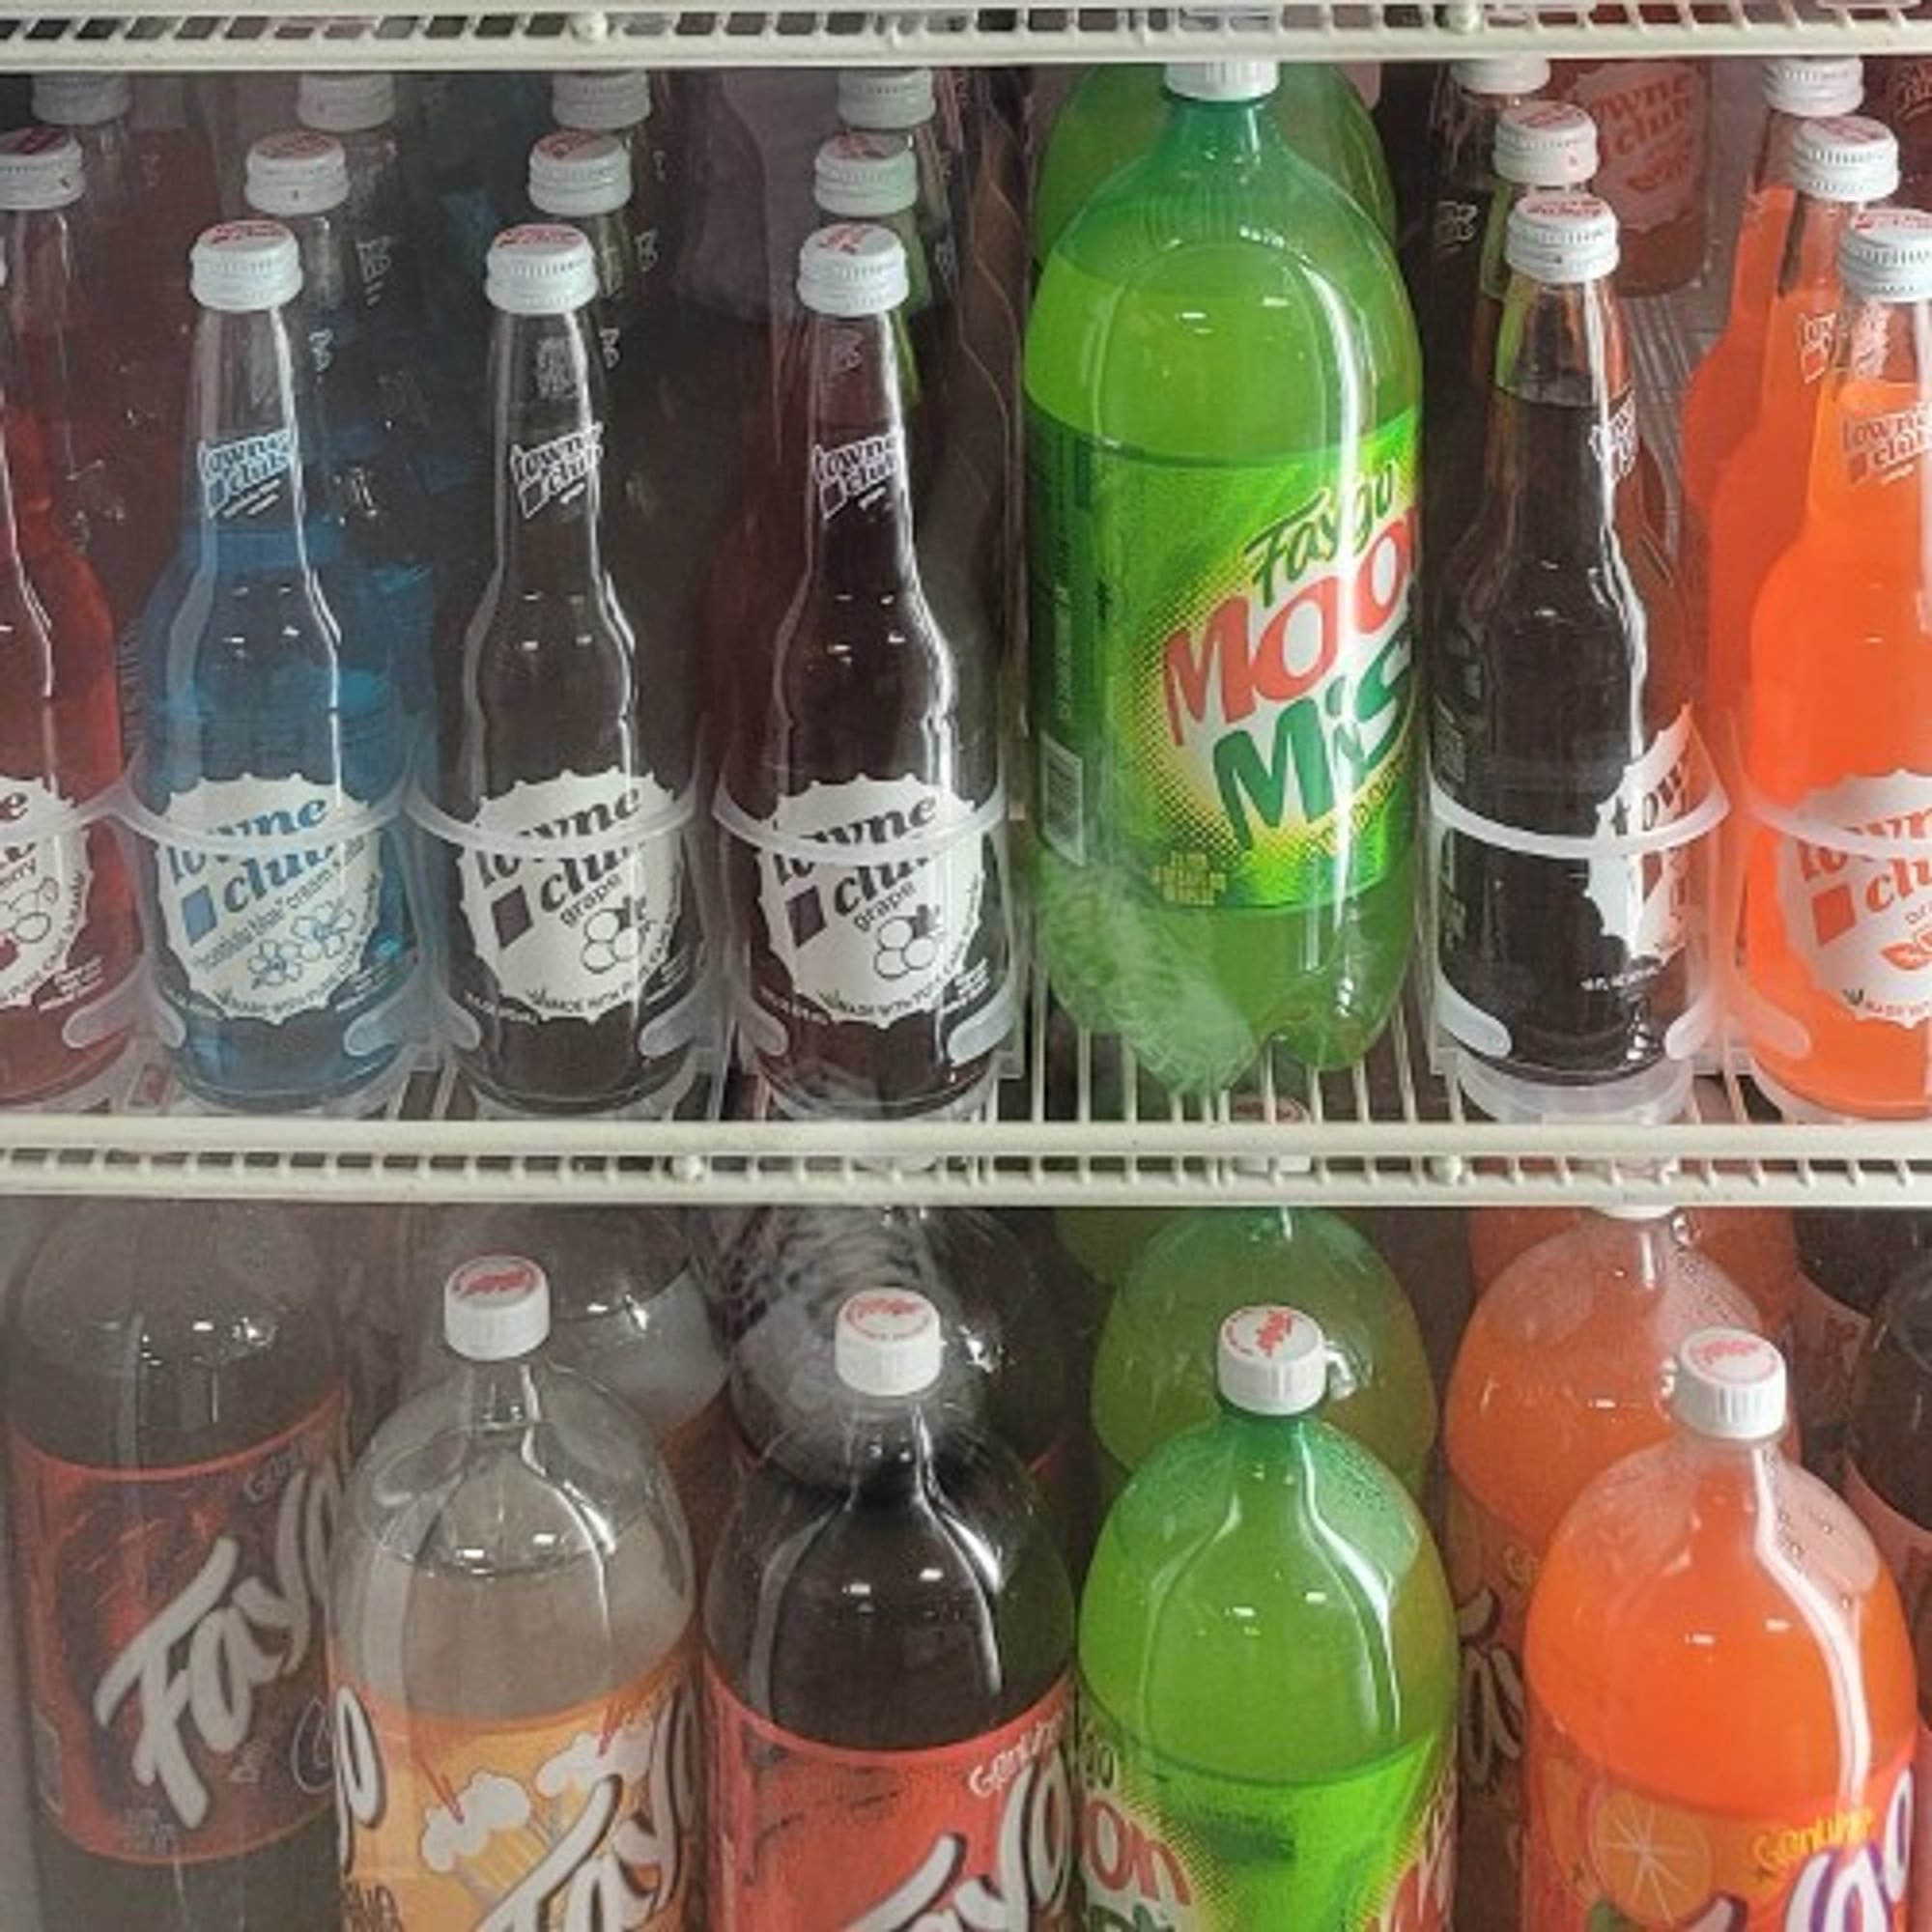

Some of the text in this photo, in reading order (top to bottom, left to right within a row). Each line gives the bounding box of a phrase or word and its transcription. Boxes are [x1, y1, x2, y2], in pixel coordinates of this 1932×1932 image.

[558, 873, 622, 928] grape
[834, 856, 931, 917] clu
[853, 881, 918, 933] grape
